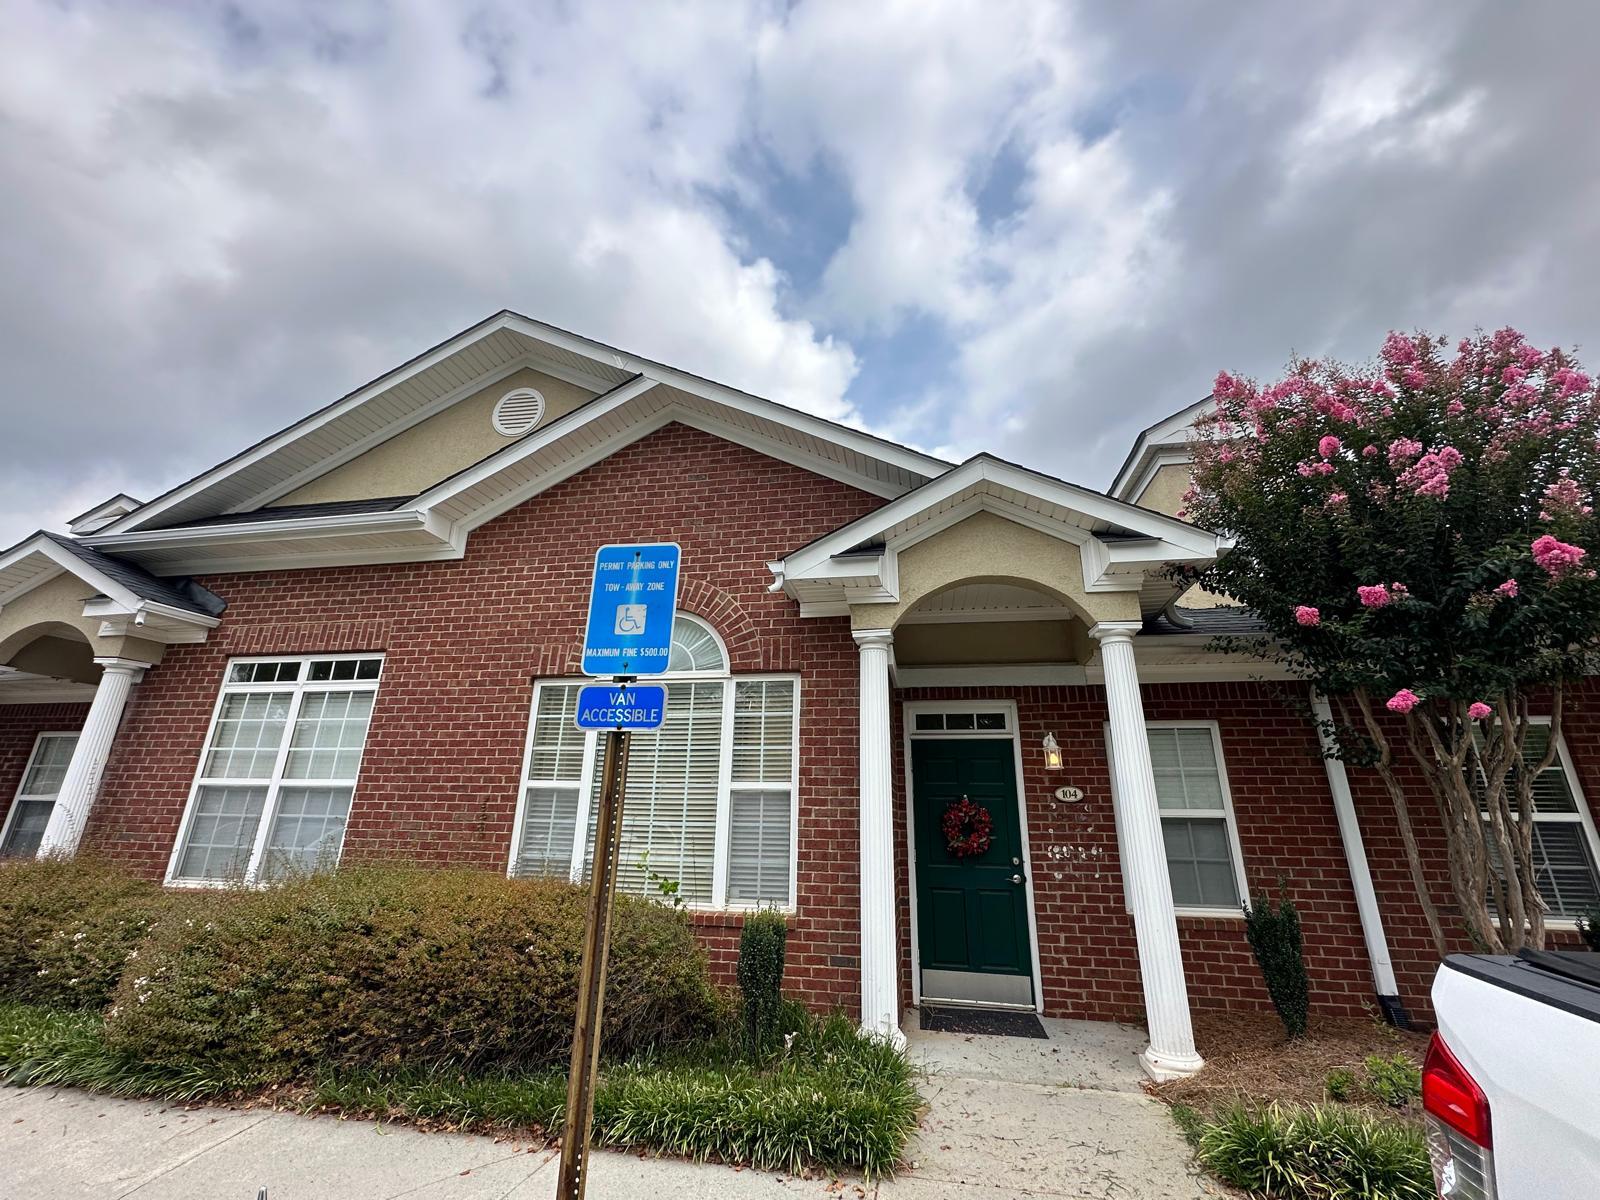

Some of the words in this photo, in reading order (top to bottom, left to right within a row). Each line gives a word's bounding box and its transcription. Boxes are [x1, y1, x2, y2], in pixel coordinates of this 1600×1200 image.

[599, 562, 624, 571] PERMIT
[627, 561, 655, 570] PARKING
[658, 560, 675, 569] ONLY
[647, 582, 665, 591] ZONE
[586, 648, 620, 657] MAXIMUM
[622, 648, 638, 657] FINE
[640, 647, 668, 657] $500.00
[609, 692, 636, 706] VAN
[581, 708, 659, 723] ACCESSIBLE
[1061, 789, 1078, 799] 104
